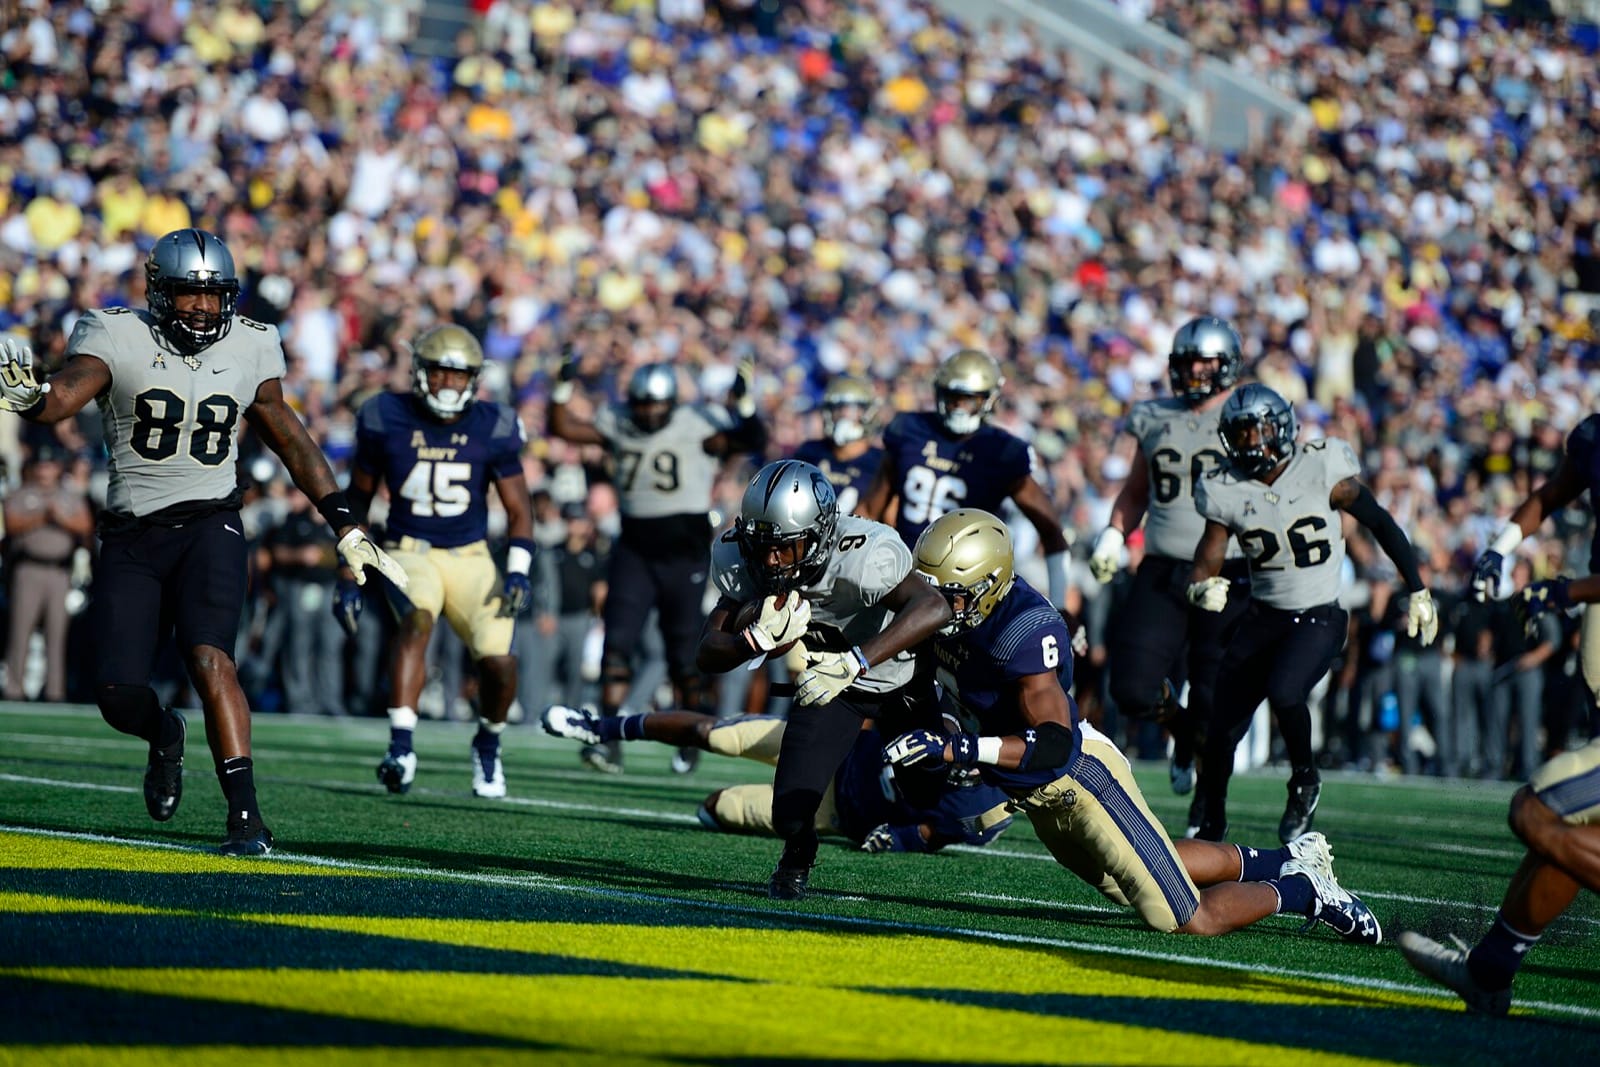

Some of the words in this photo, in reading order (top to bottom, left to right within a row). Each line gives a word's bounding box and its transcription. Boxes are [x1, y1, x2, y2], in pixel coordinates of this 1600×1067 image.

[128, 386, 240, 468] 88
[400, 460, 472, 518] 45
[619, 449, 679, 493] 79
[903, 465, 968, 525] 96
[838, 533, 868, 552] 9
[1241, 515, 1331, 572] 26
[1041, 634, 1059, 669] 6
